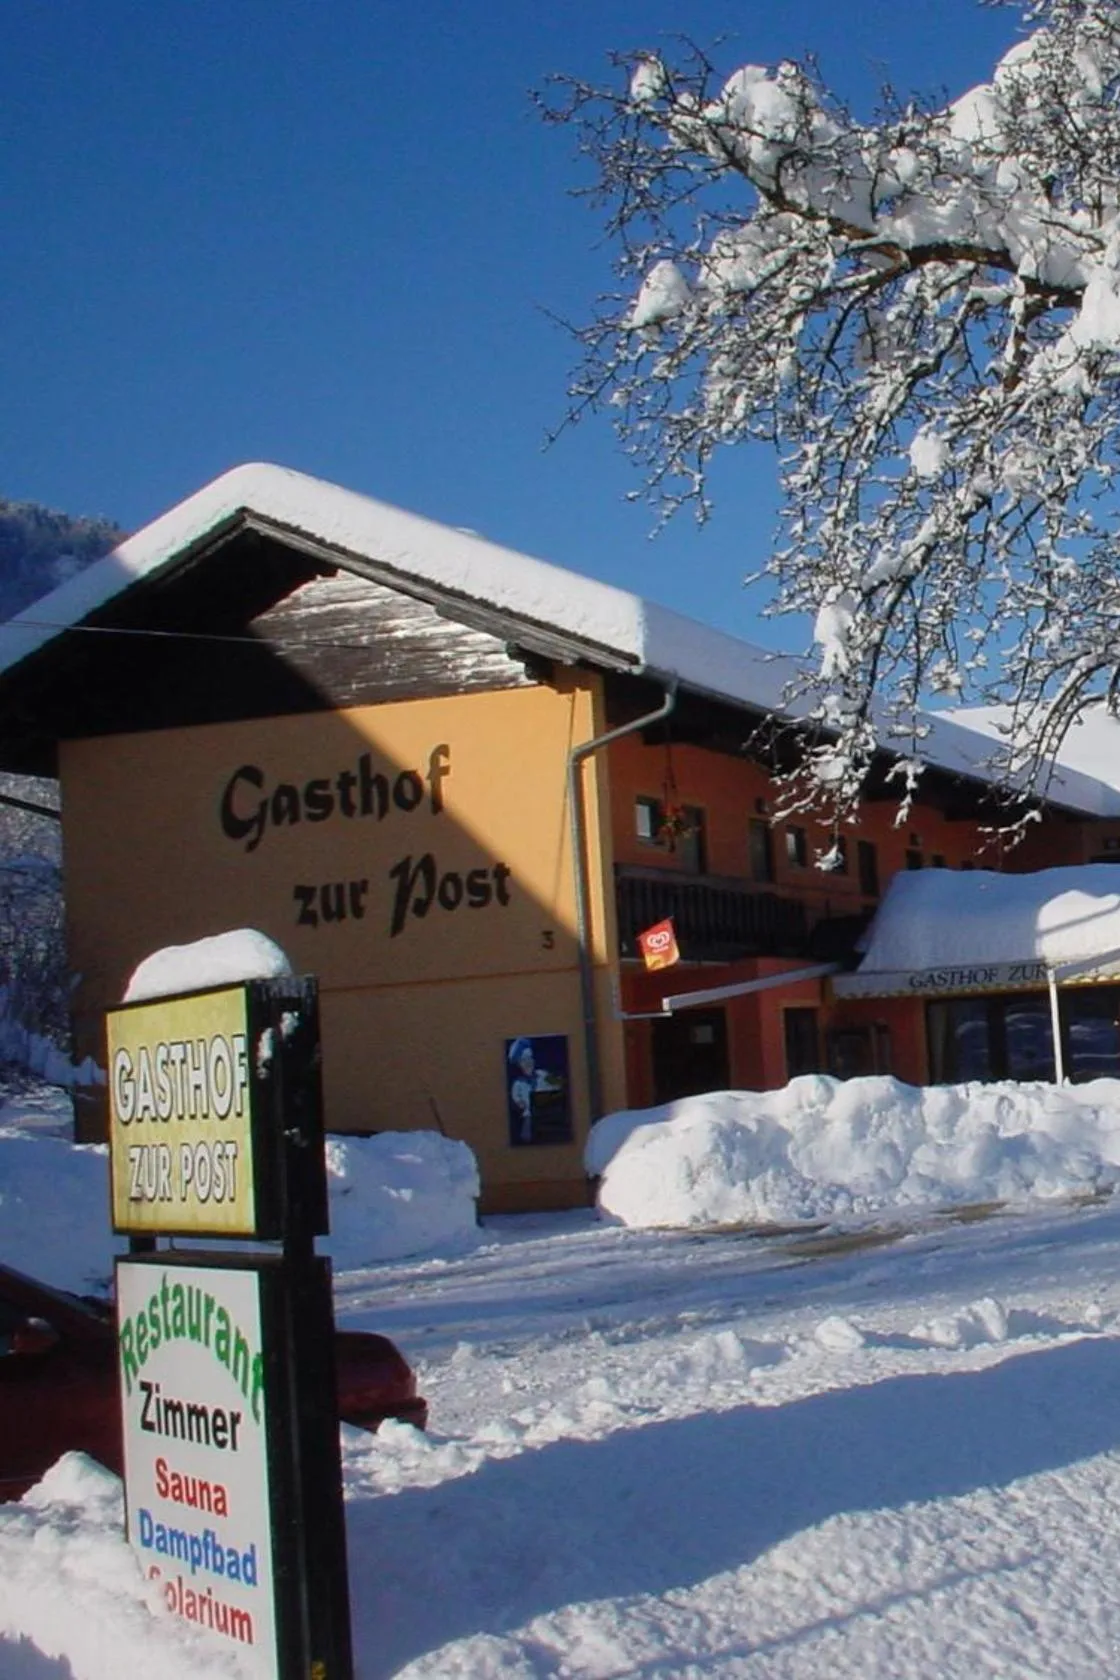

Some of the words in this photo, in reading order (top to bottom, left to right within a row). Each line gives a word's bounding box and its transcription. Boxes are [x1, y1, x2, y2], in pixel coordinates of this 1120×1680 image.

[220, 743, 451, 853] Gasthof
[294, 878, 369, 929] zur
[389, 853, 511, 938] Post
[541, 931, 555, 950] 3
[908, 967, 999, 989] GASTHOF
[114, 1034, 248, 1125] GASTHOF
[129, 1143, 172, 1202] ZUR
[180, 1140, 237, 1204] POST
[119, 1271, 264, 1425] Restaurant
[139, 1380, 242, 1452] Zimmer
[155, 1457, 228, 1518] Sauna
[138, 1508, 258, 1587] Dampfbad
